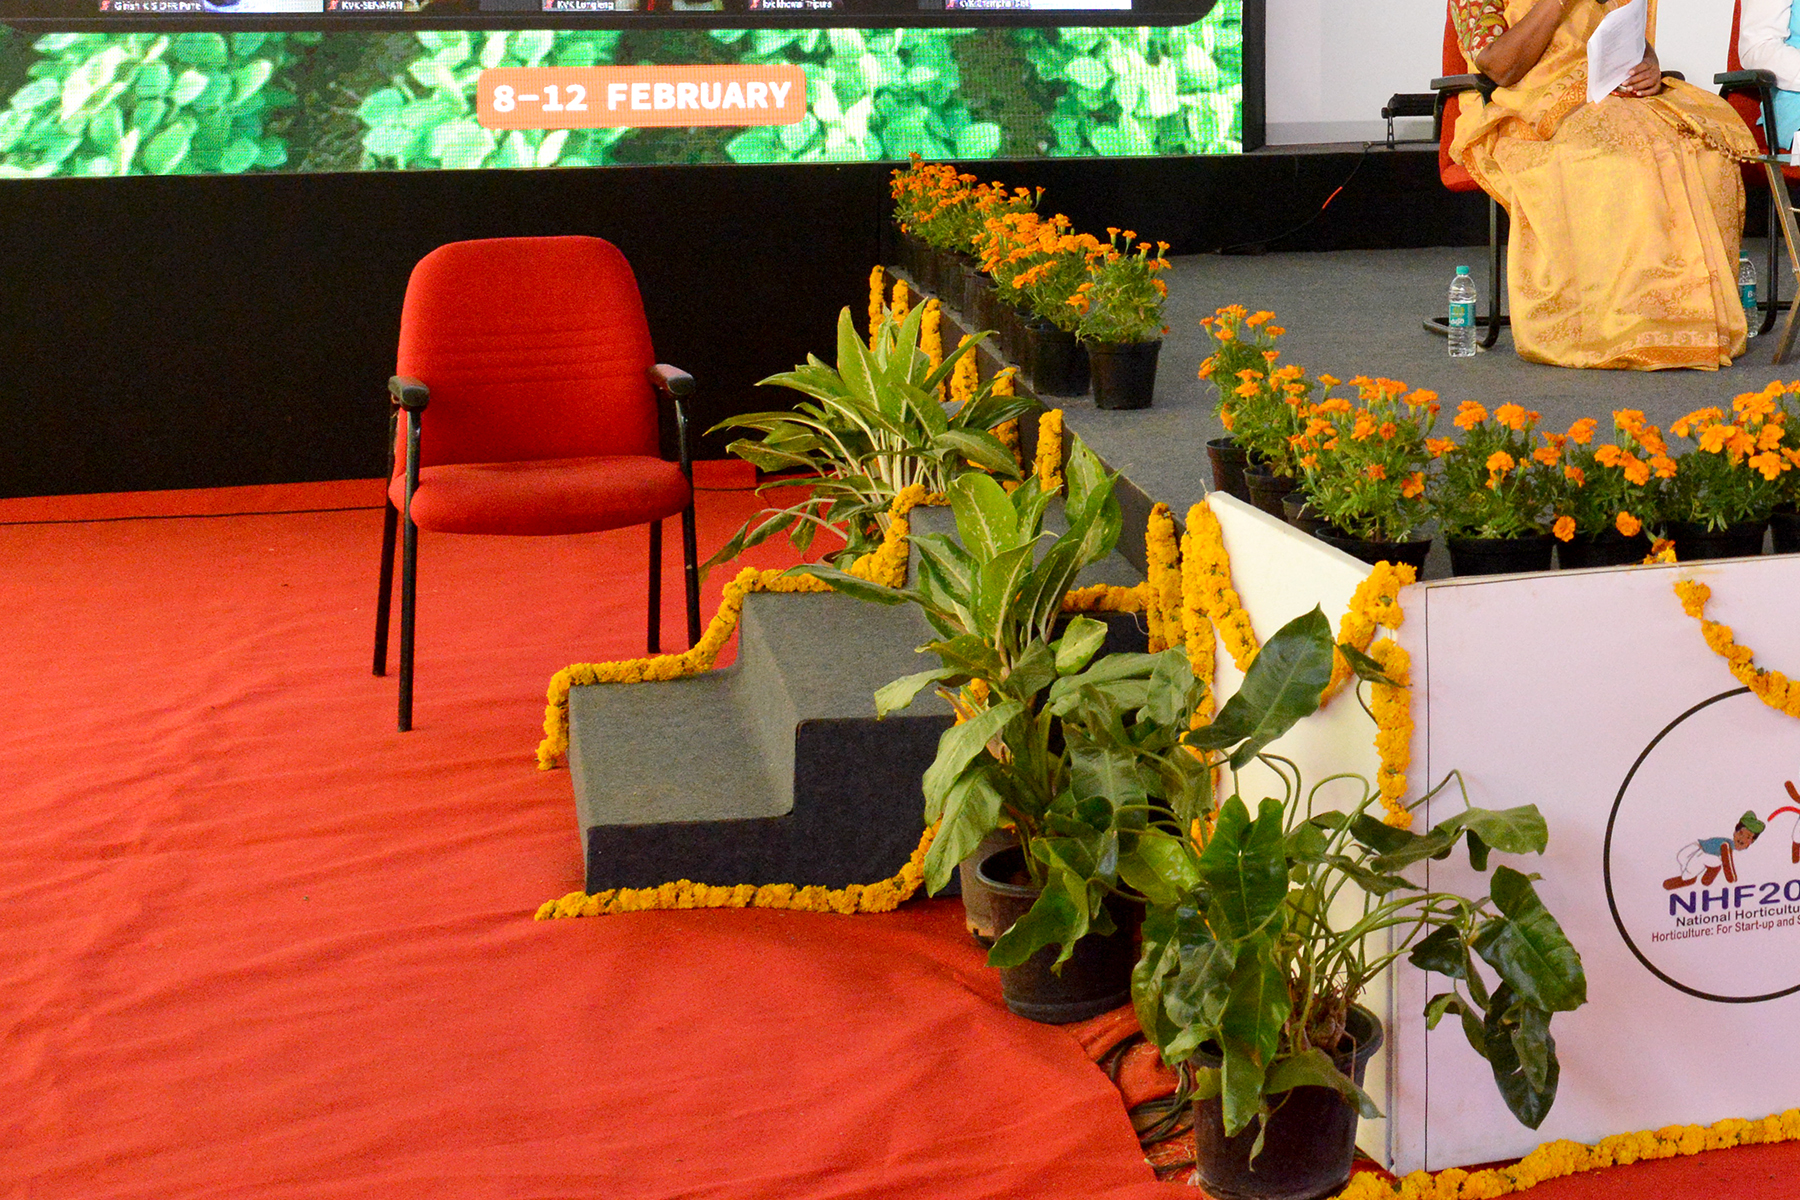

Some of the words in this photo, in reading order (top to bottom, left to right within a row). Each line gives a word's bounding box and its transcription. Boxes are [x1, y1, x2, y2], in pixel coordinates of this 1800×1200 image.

[606, 81, 792, 111] FEBRUARY
[1651, 926, 1714, 943] Horticulture:
[1716, 923, 1732, 936] For
[1735, 918, 1775, 935] Start-up
[1776, 914, 1795, 928] and
[1675, 910, 1732, 927] National
